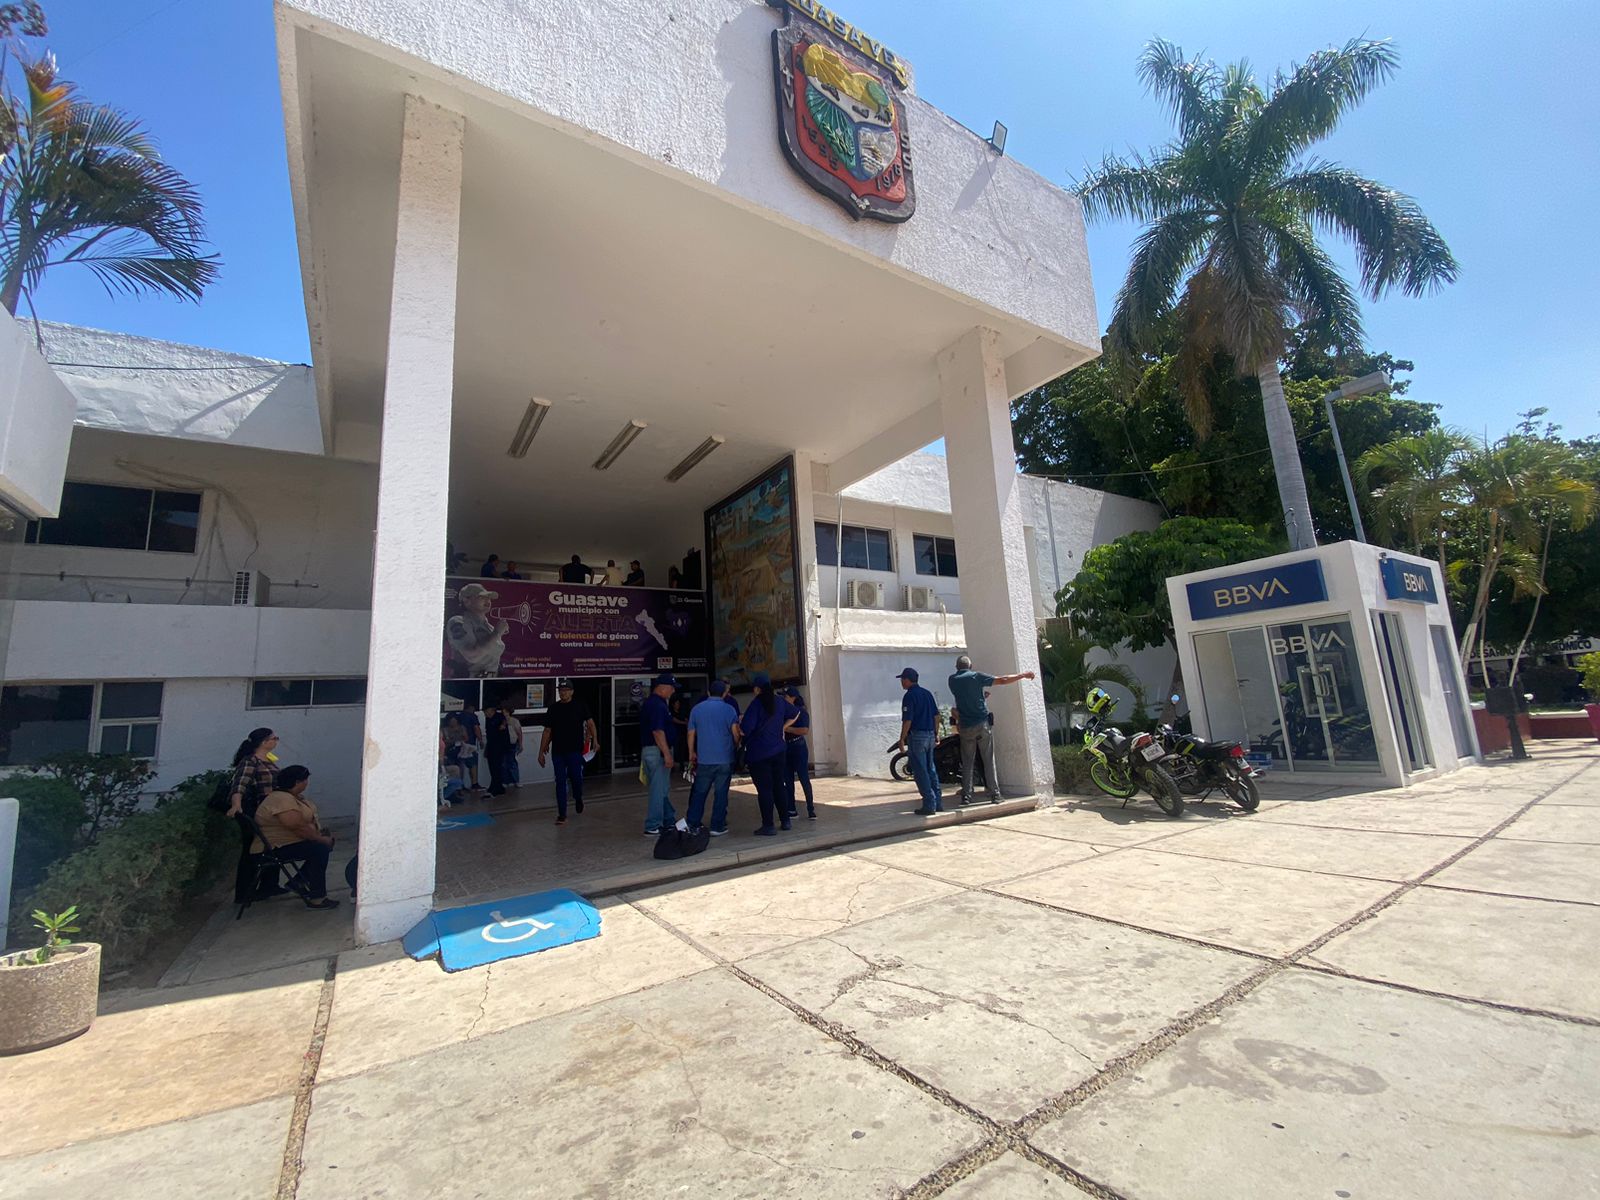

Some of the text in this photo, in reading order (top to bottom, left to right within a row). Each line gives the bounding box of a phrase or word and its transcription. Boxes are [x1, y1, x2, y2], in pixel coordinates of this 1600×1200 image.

[789, 0, 897, 68] UASAVE
[1213, 577, 1290, 608] BBVA
[1403, 572, 1428, 593] BBVA
[548, 590, 629, 607] Guasave
[558, 606, 602, 615] municipio
[543, 611, 637, 632] ALERTA
[539, 631, 639, 641] de violencia de género
[1270, 630, 1346, 656] BBVA
